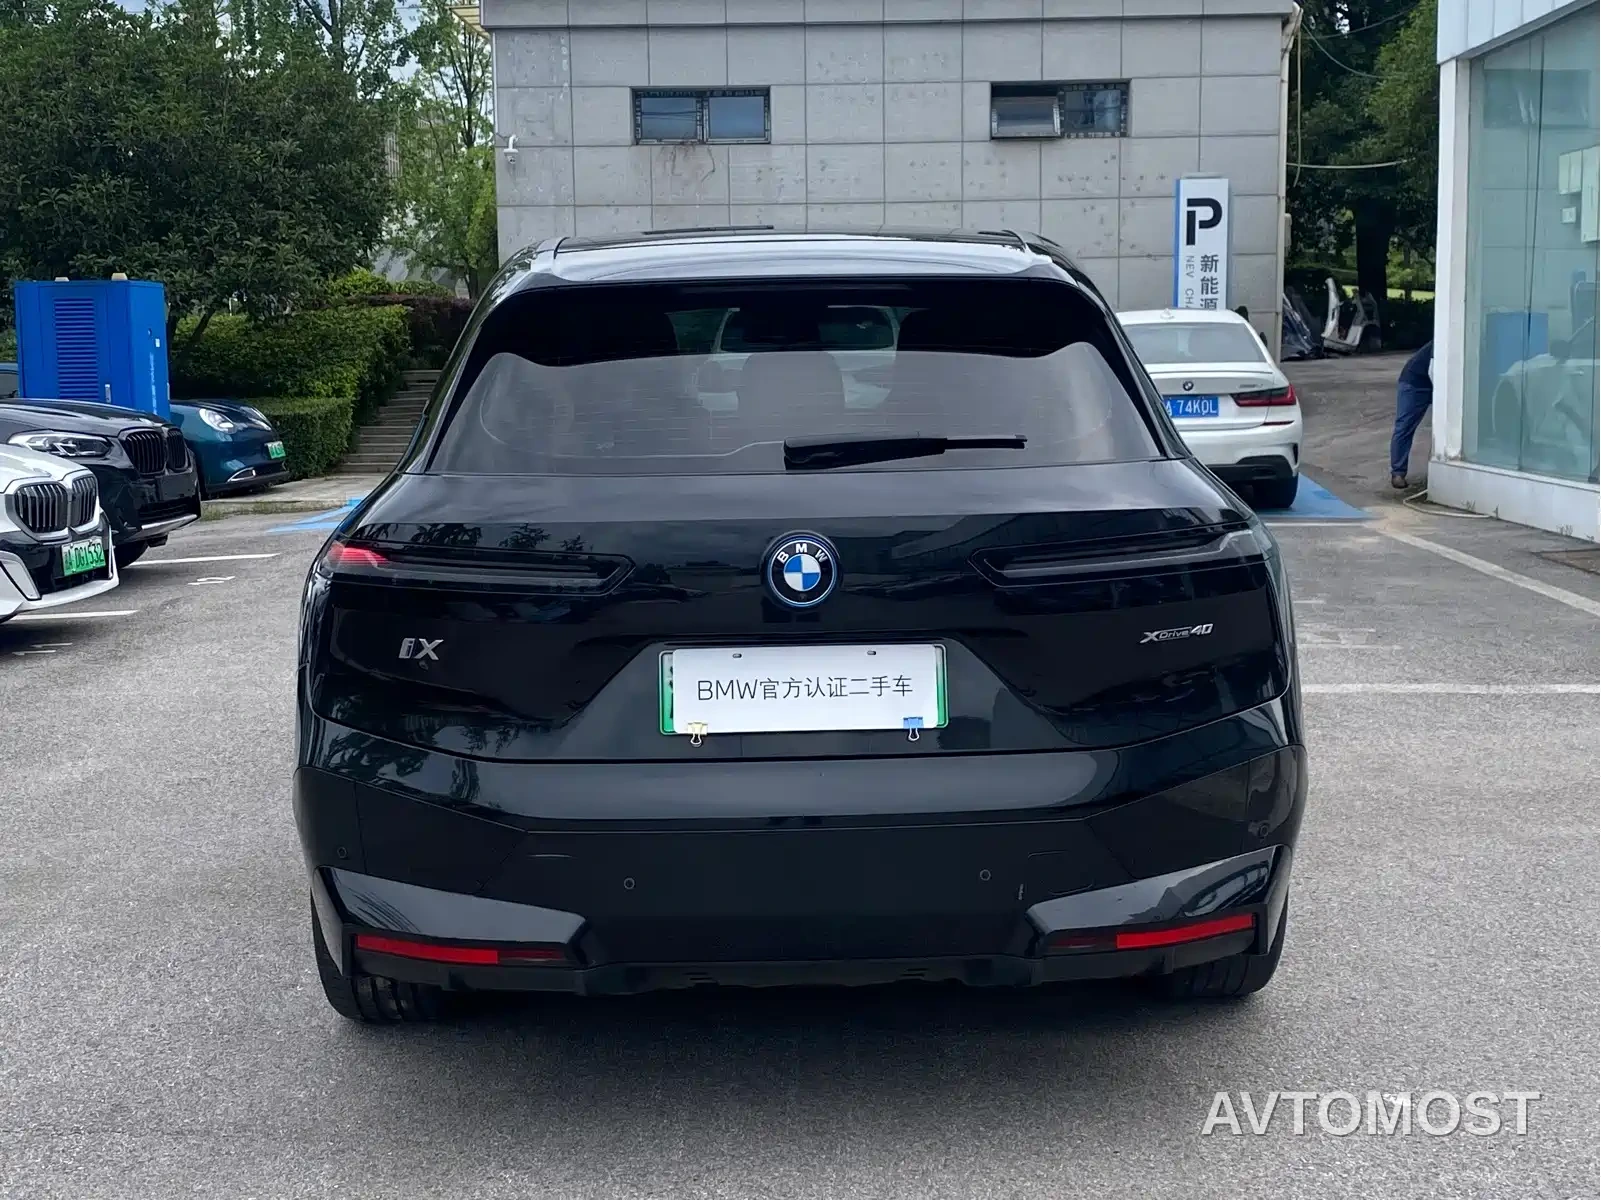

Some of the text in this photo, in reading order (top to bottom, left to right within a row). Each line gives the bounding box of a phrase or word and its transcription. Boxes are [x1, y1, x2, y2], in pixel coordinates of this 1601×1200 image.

[1186, 197, 1223, 246] P
[1185, 255, 1196, 309] NEV CH
[1199, 254, 1219, 310] 新能源
[777, 543, 828, 564] BMW
[398, 637, 444, 660] iX
